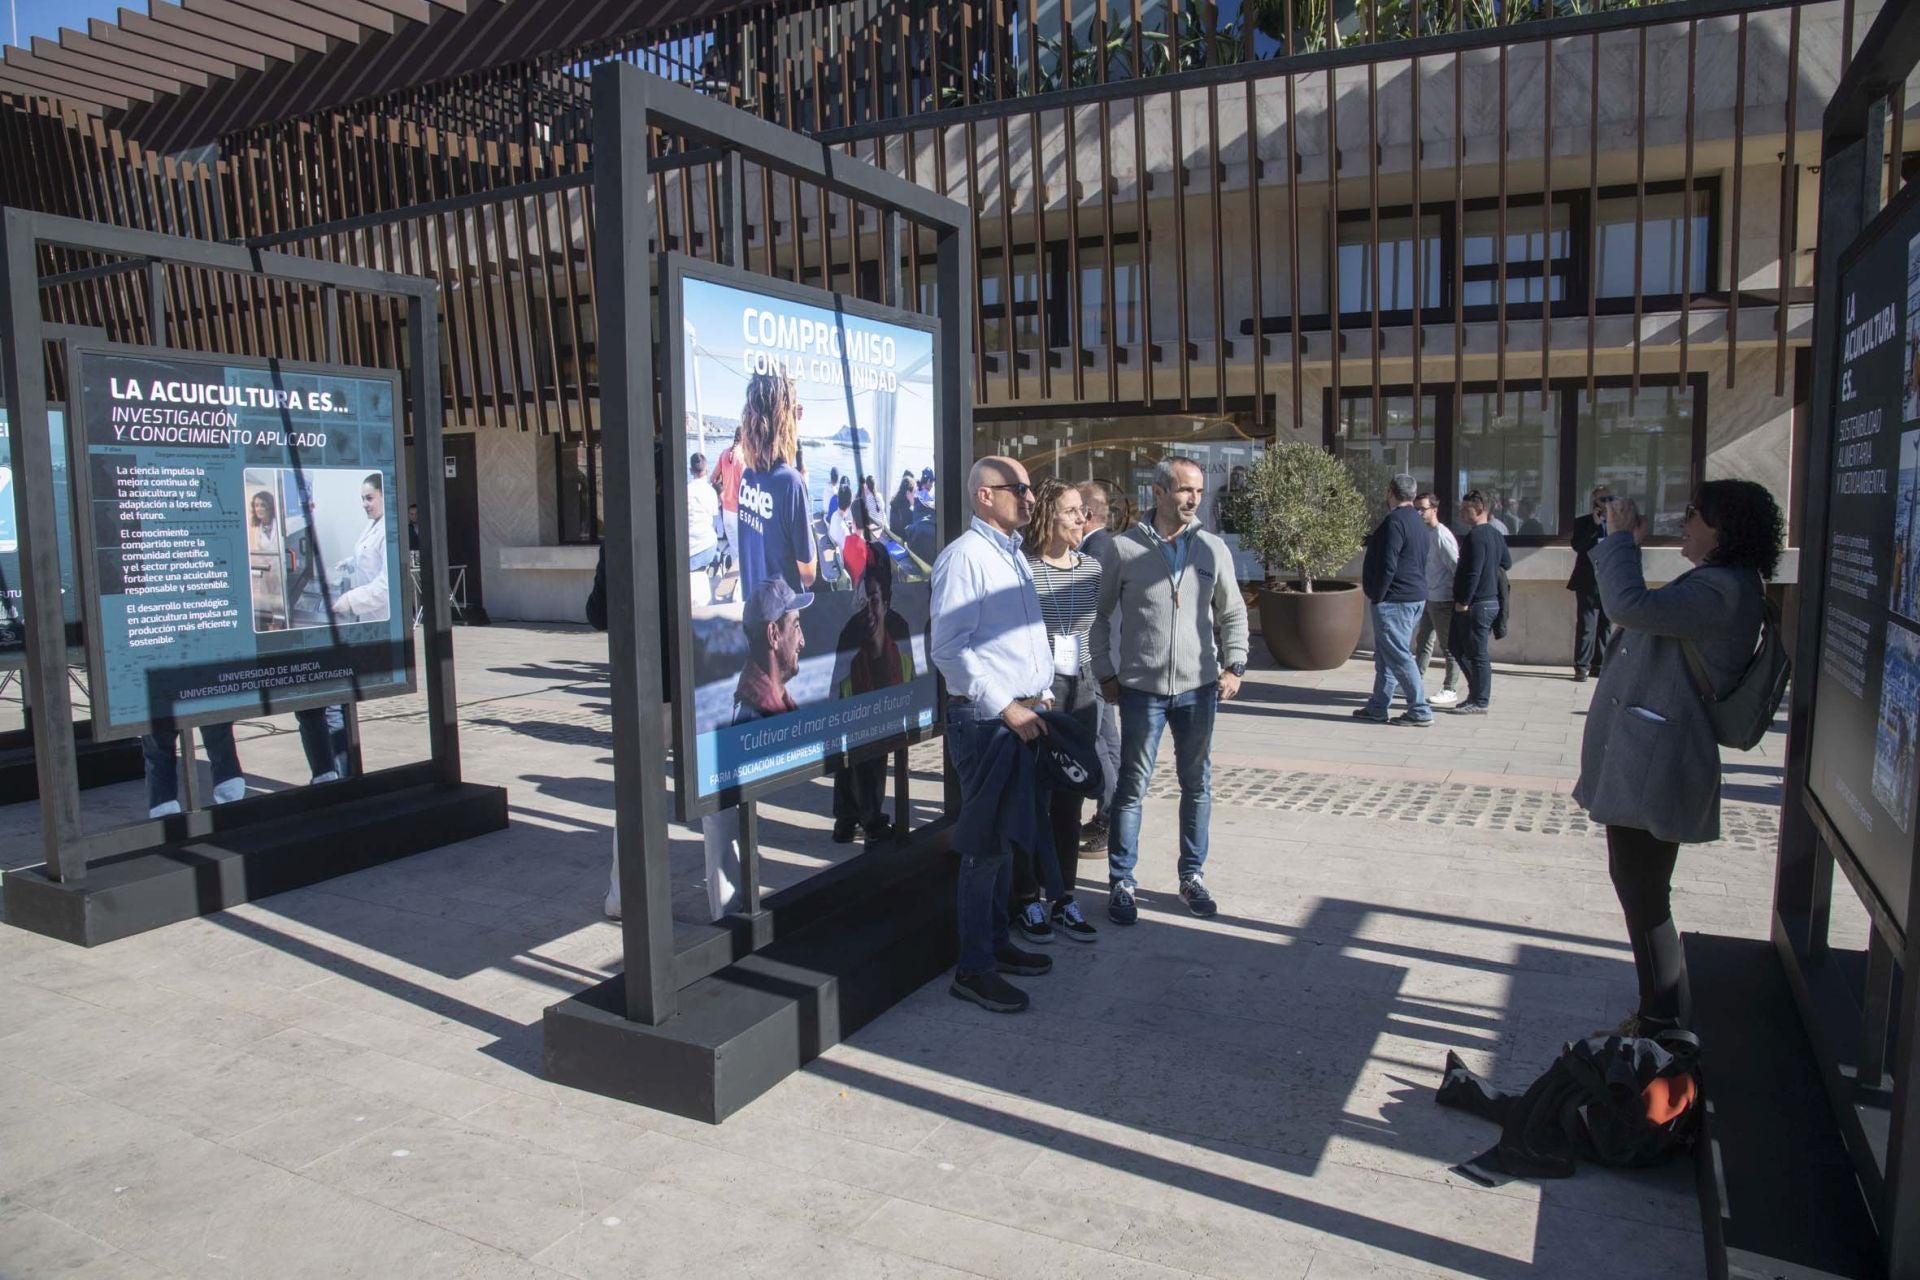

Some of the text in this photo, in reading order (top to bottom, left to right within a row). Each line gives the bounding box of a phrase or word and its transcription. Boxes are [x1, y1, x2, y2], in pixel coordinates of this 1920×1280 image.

[1846, 292, 1856, 325] LA
[743, 308, 896, 368] COMPROMISO
[1844, 302, 1896, 364] ACUICULTURA
[744, 348, 782, 377] CON
[786, 354, 806, 380] LA
[110, 378, 348, 413] LA ACUICULTURA ES...
[112, 406, 237, 427] INVESTIGACIÓN
[114, 426, 327, 447] Y CONOCIMIENTO APLICADO
[117, 466, 204, 476] La ciencia impulsa la
[118, 478, 200, 488] mejora continua de
[118, 489, 126, 497] la
[129, 489, 177, 497] acuicultura
[119, 500, 168, 510] adaptación
[176, 500, 189, 508] los
[120, 512, 166, 520] del futuro.
[120, 529, 189, 538] El conocimiento
[122, 540, 172, 550] compartido
[122, 550, 209, 560] comunidad científica
[130, 564, 139, 572] el
[141, 563, 168, 571] sector
[170, 561, 214, 571] productivo
[124, 574, 164, 583] fortalece
[182, 570, 228, 580] acuicultura
[125, 580, 230, 595] responsable y sostenible.
[127, 600, 229, 613] El desarrollo tecnológico
[140, 614, 188, 624] acuicultura
[189, 610, 222, 620] impulsa
[128, 620, 238, 638] producción más eficiente y
[129, 636, 176, 647] sostenible.
[218, 662, 321, 682] UNIVERSIDAD DE MURCIA
[180, 684, 240, 699] UNIVERSIDAD
[296, 674, 307, 683] DE
[308, 668, 354, 681] CARTAGENA
[791, 726, 802, 738] el
[804, 717, 826, 734] mar
[828, 714, 840, 726] es
[842, 704, 872, 724] cuidar
[874, 700, 882, 714] el
[710, 770, 730, 785] FARM
[776, 754, 784, 765] DE
[786, 743, 820, 762] EMPRESAS
